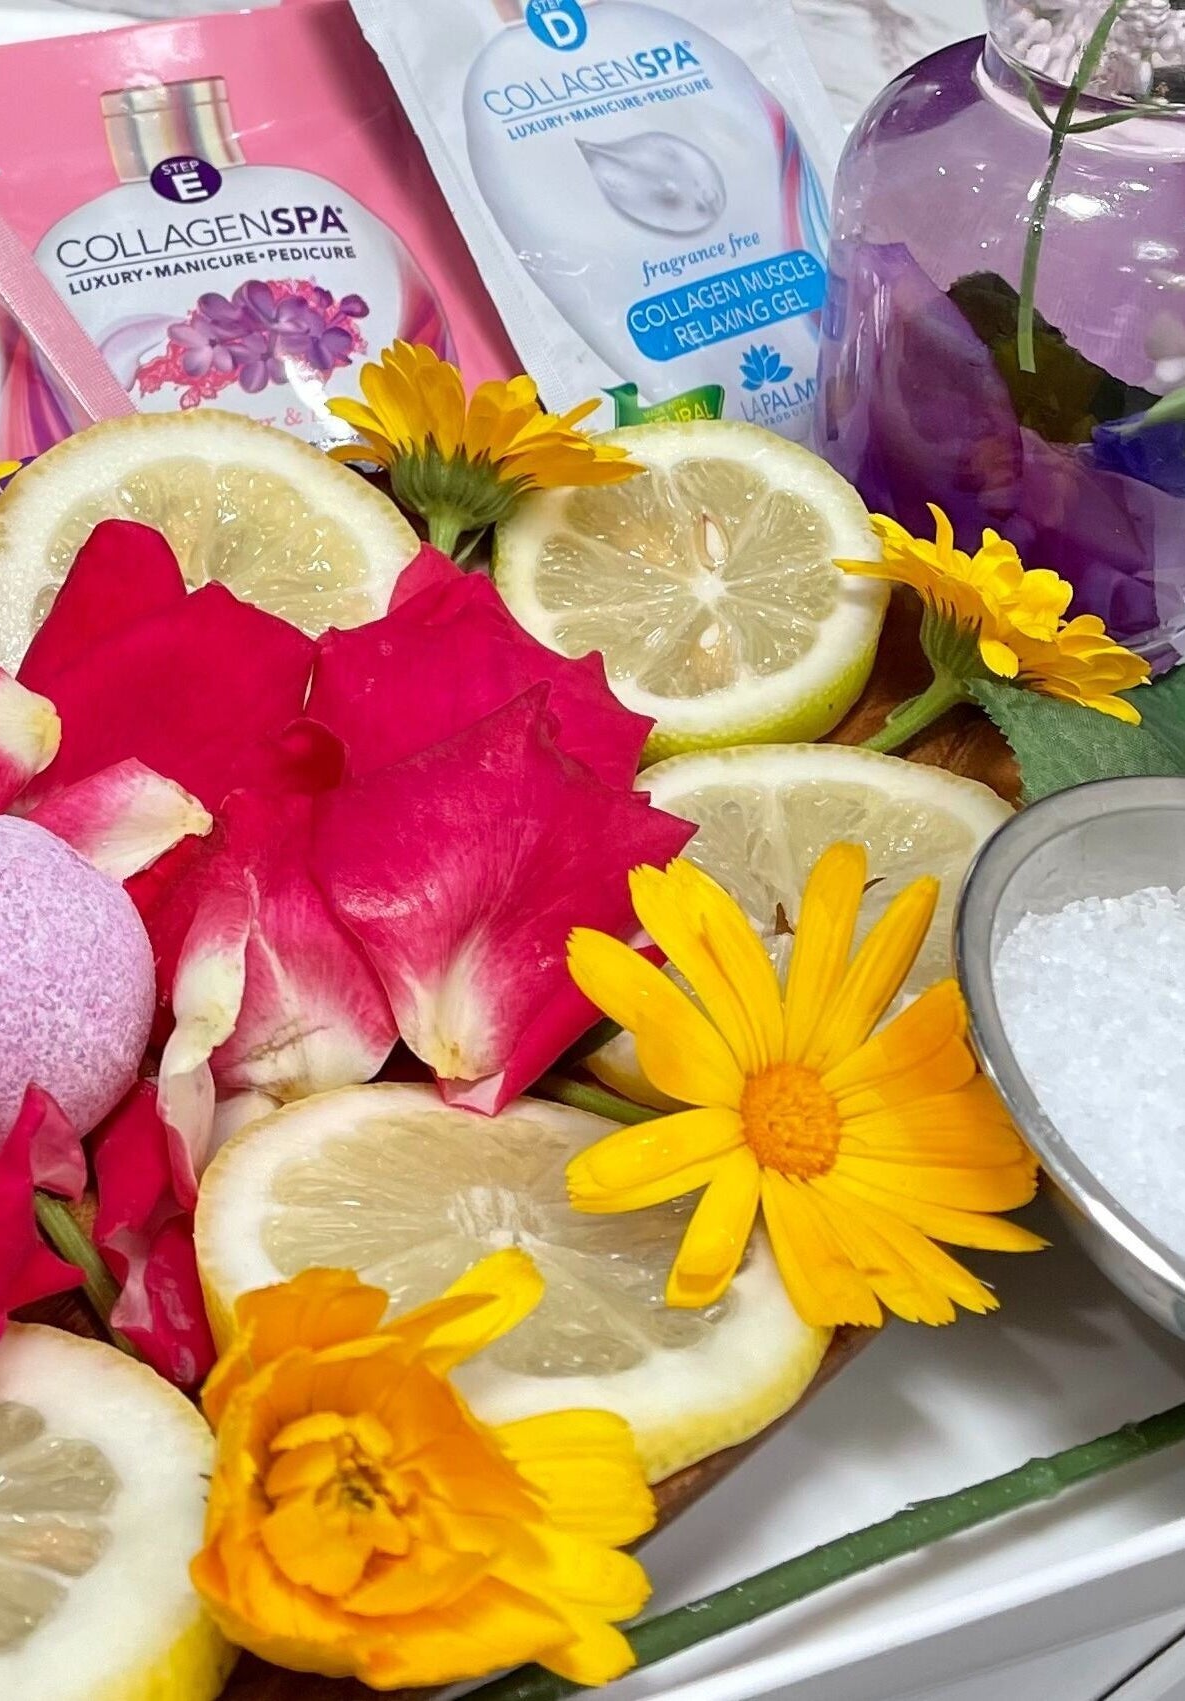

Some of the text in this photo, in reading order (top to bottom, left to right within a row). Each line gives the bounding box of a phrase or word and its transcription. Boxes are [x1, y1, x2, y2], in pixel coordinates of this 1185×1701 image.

[531, 0, 562, 15] STEP
[540, 10, 578, 47] D
[161, 160, 200, 175] STEP
[171, 171, 208, 200] E
[642, 231, 761, 287] fragrance free
[630, 277, 741, 333] COLLAGEN
[673, 288, 810, 349] RELAXING GEL
